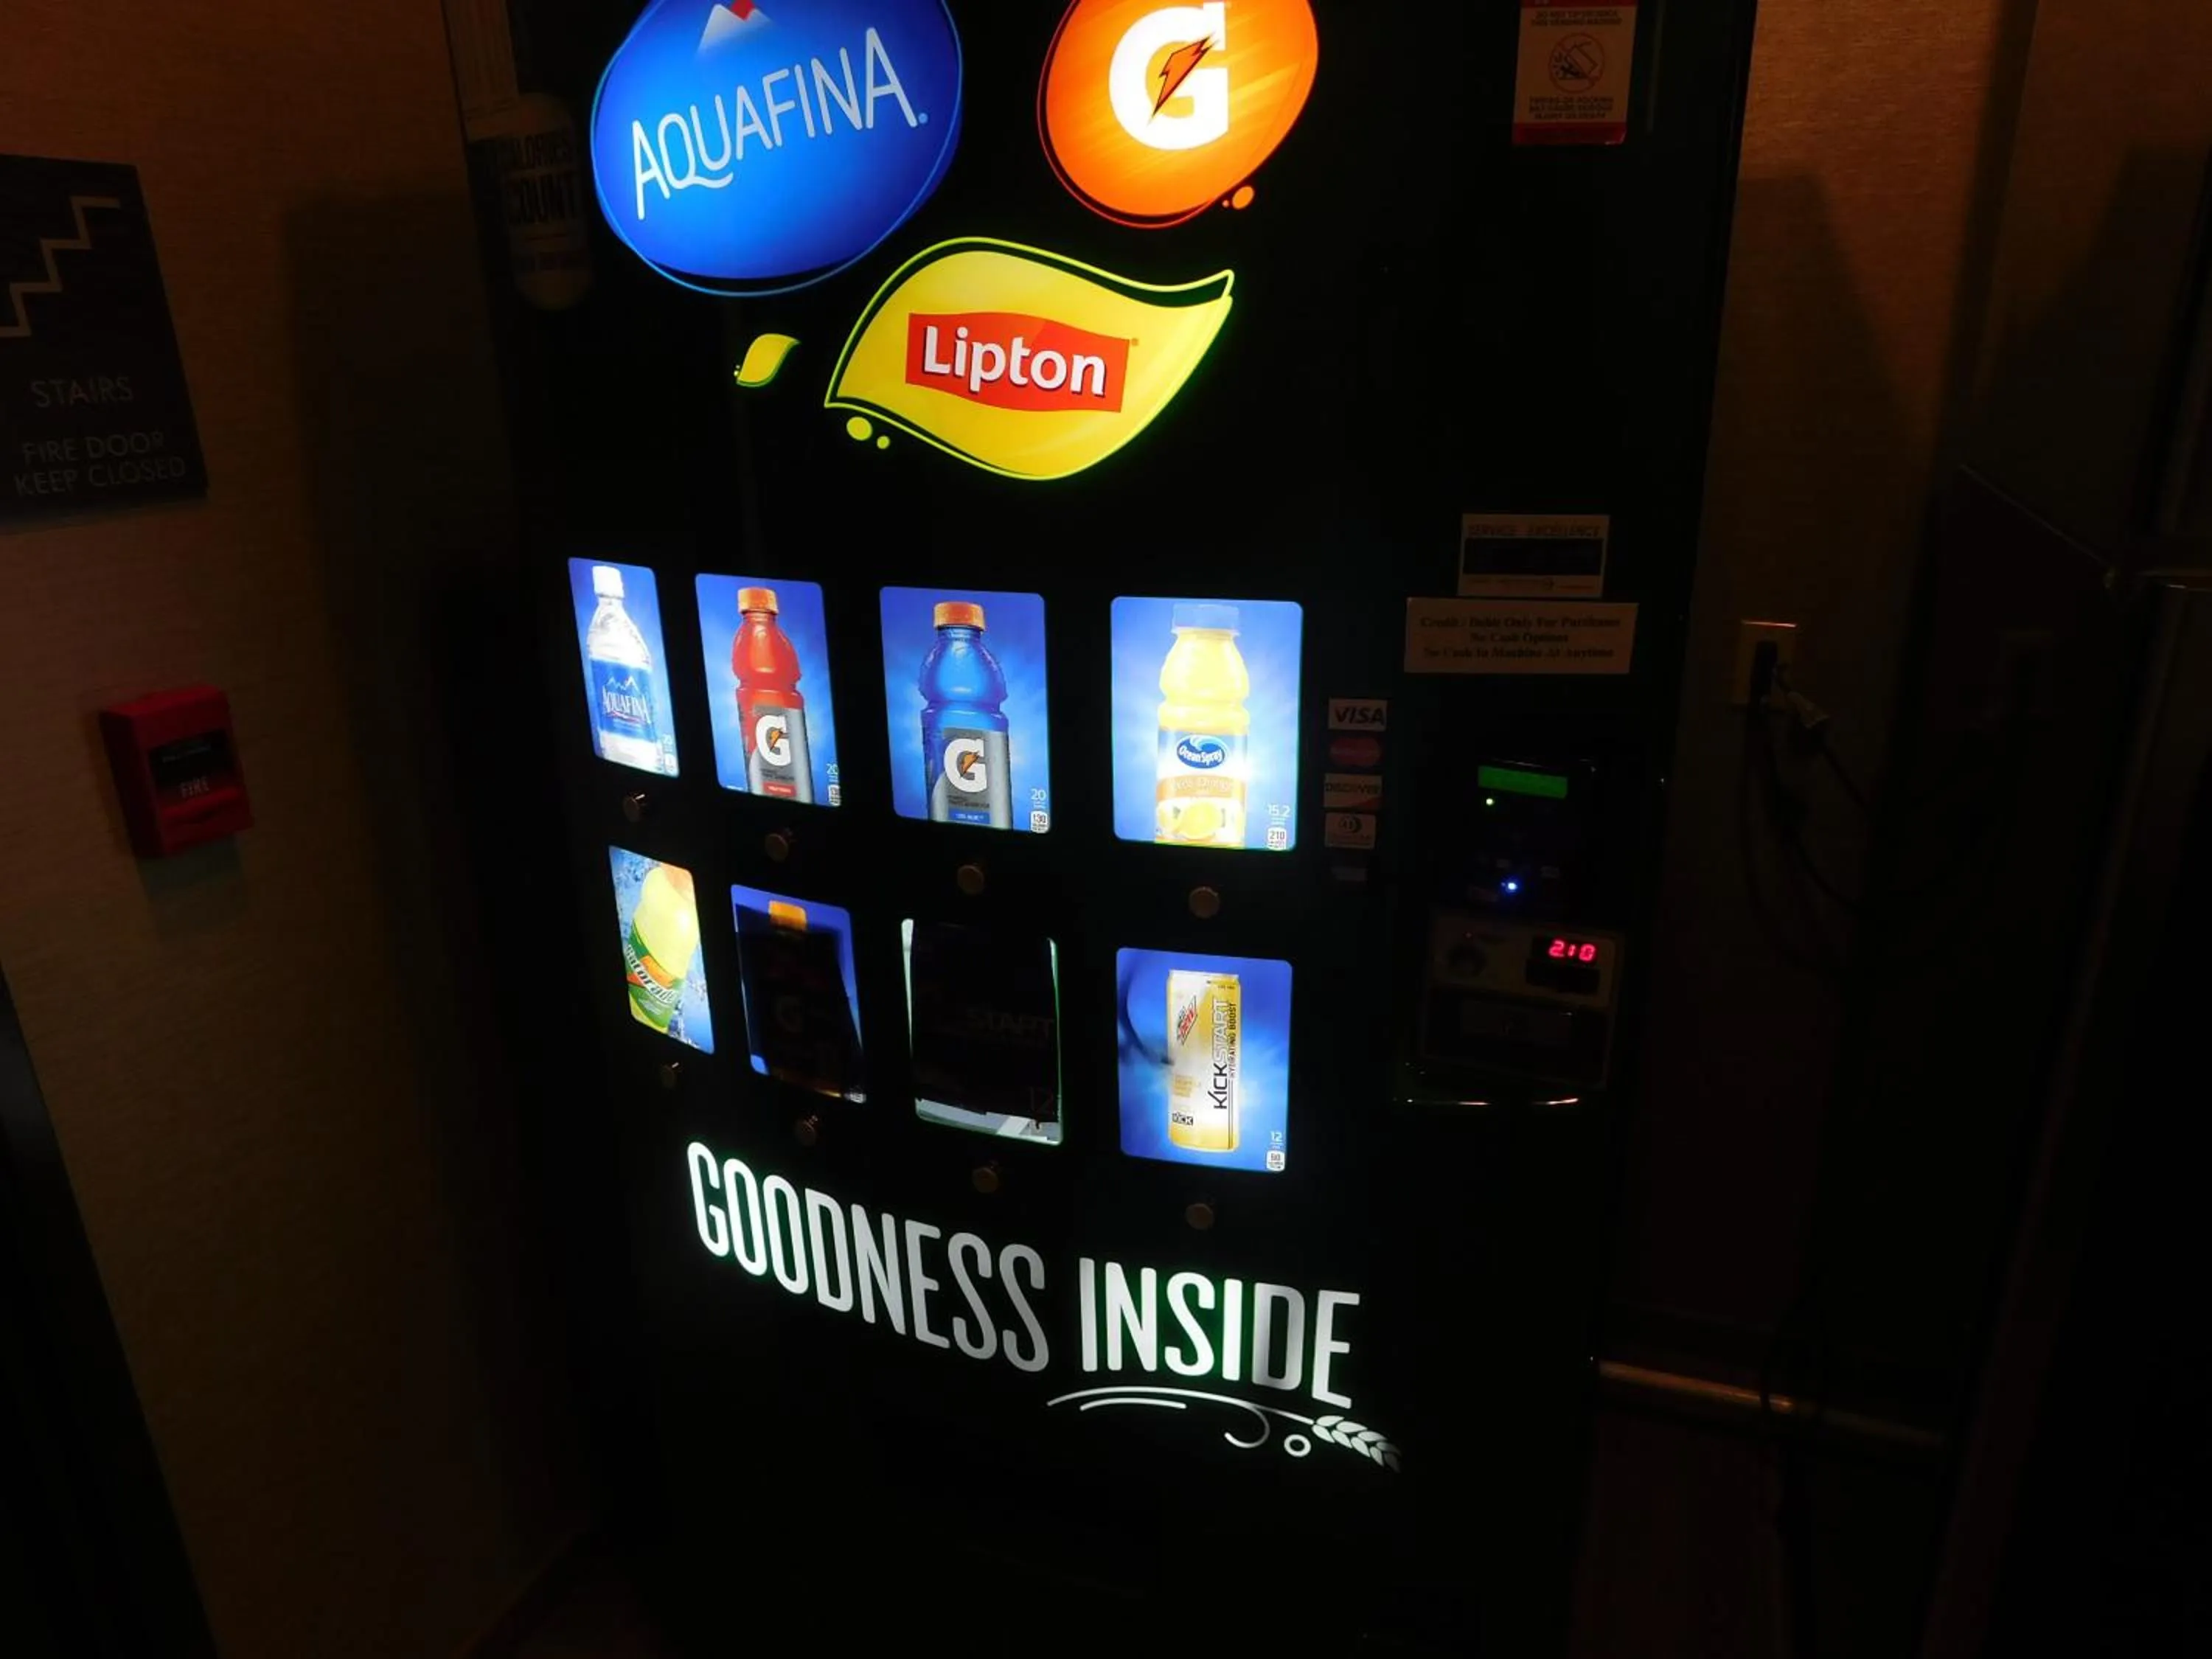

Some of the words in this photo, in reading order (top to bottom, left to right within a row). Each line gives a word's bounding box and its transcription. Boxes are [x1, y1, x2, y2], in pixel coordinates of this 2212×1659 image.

[1108, 1, 1230, 150] G
[632, 27, 920, 221] AQUAFINA
[923, 324, 1106, 397] Lipton
[31, 375, 133, 408] STAIRS
[23, 438, 78, 466] FIRE
[14, 470, 77, 495] KEEP
[88, 455, 186, 487] CLOSED
[602, 684, 652, 725] AQUAFINA
[1335, 706, 1385, 726] VISA
[756, 714, 791, 766] G
[943, 738, 988, 793] G
[1030, 788, 1046, 801] 20
[1269, 830, 1285, 840] 210
[1229, 1003, 1237, 1031] BOOST
[1270, 1131, 1282, 1142] 12
[686, 1141, 1051, 1373] GOODNESS
[1079, 1256, 1361, 1410] INSIDE
